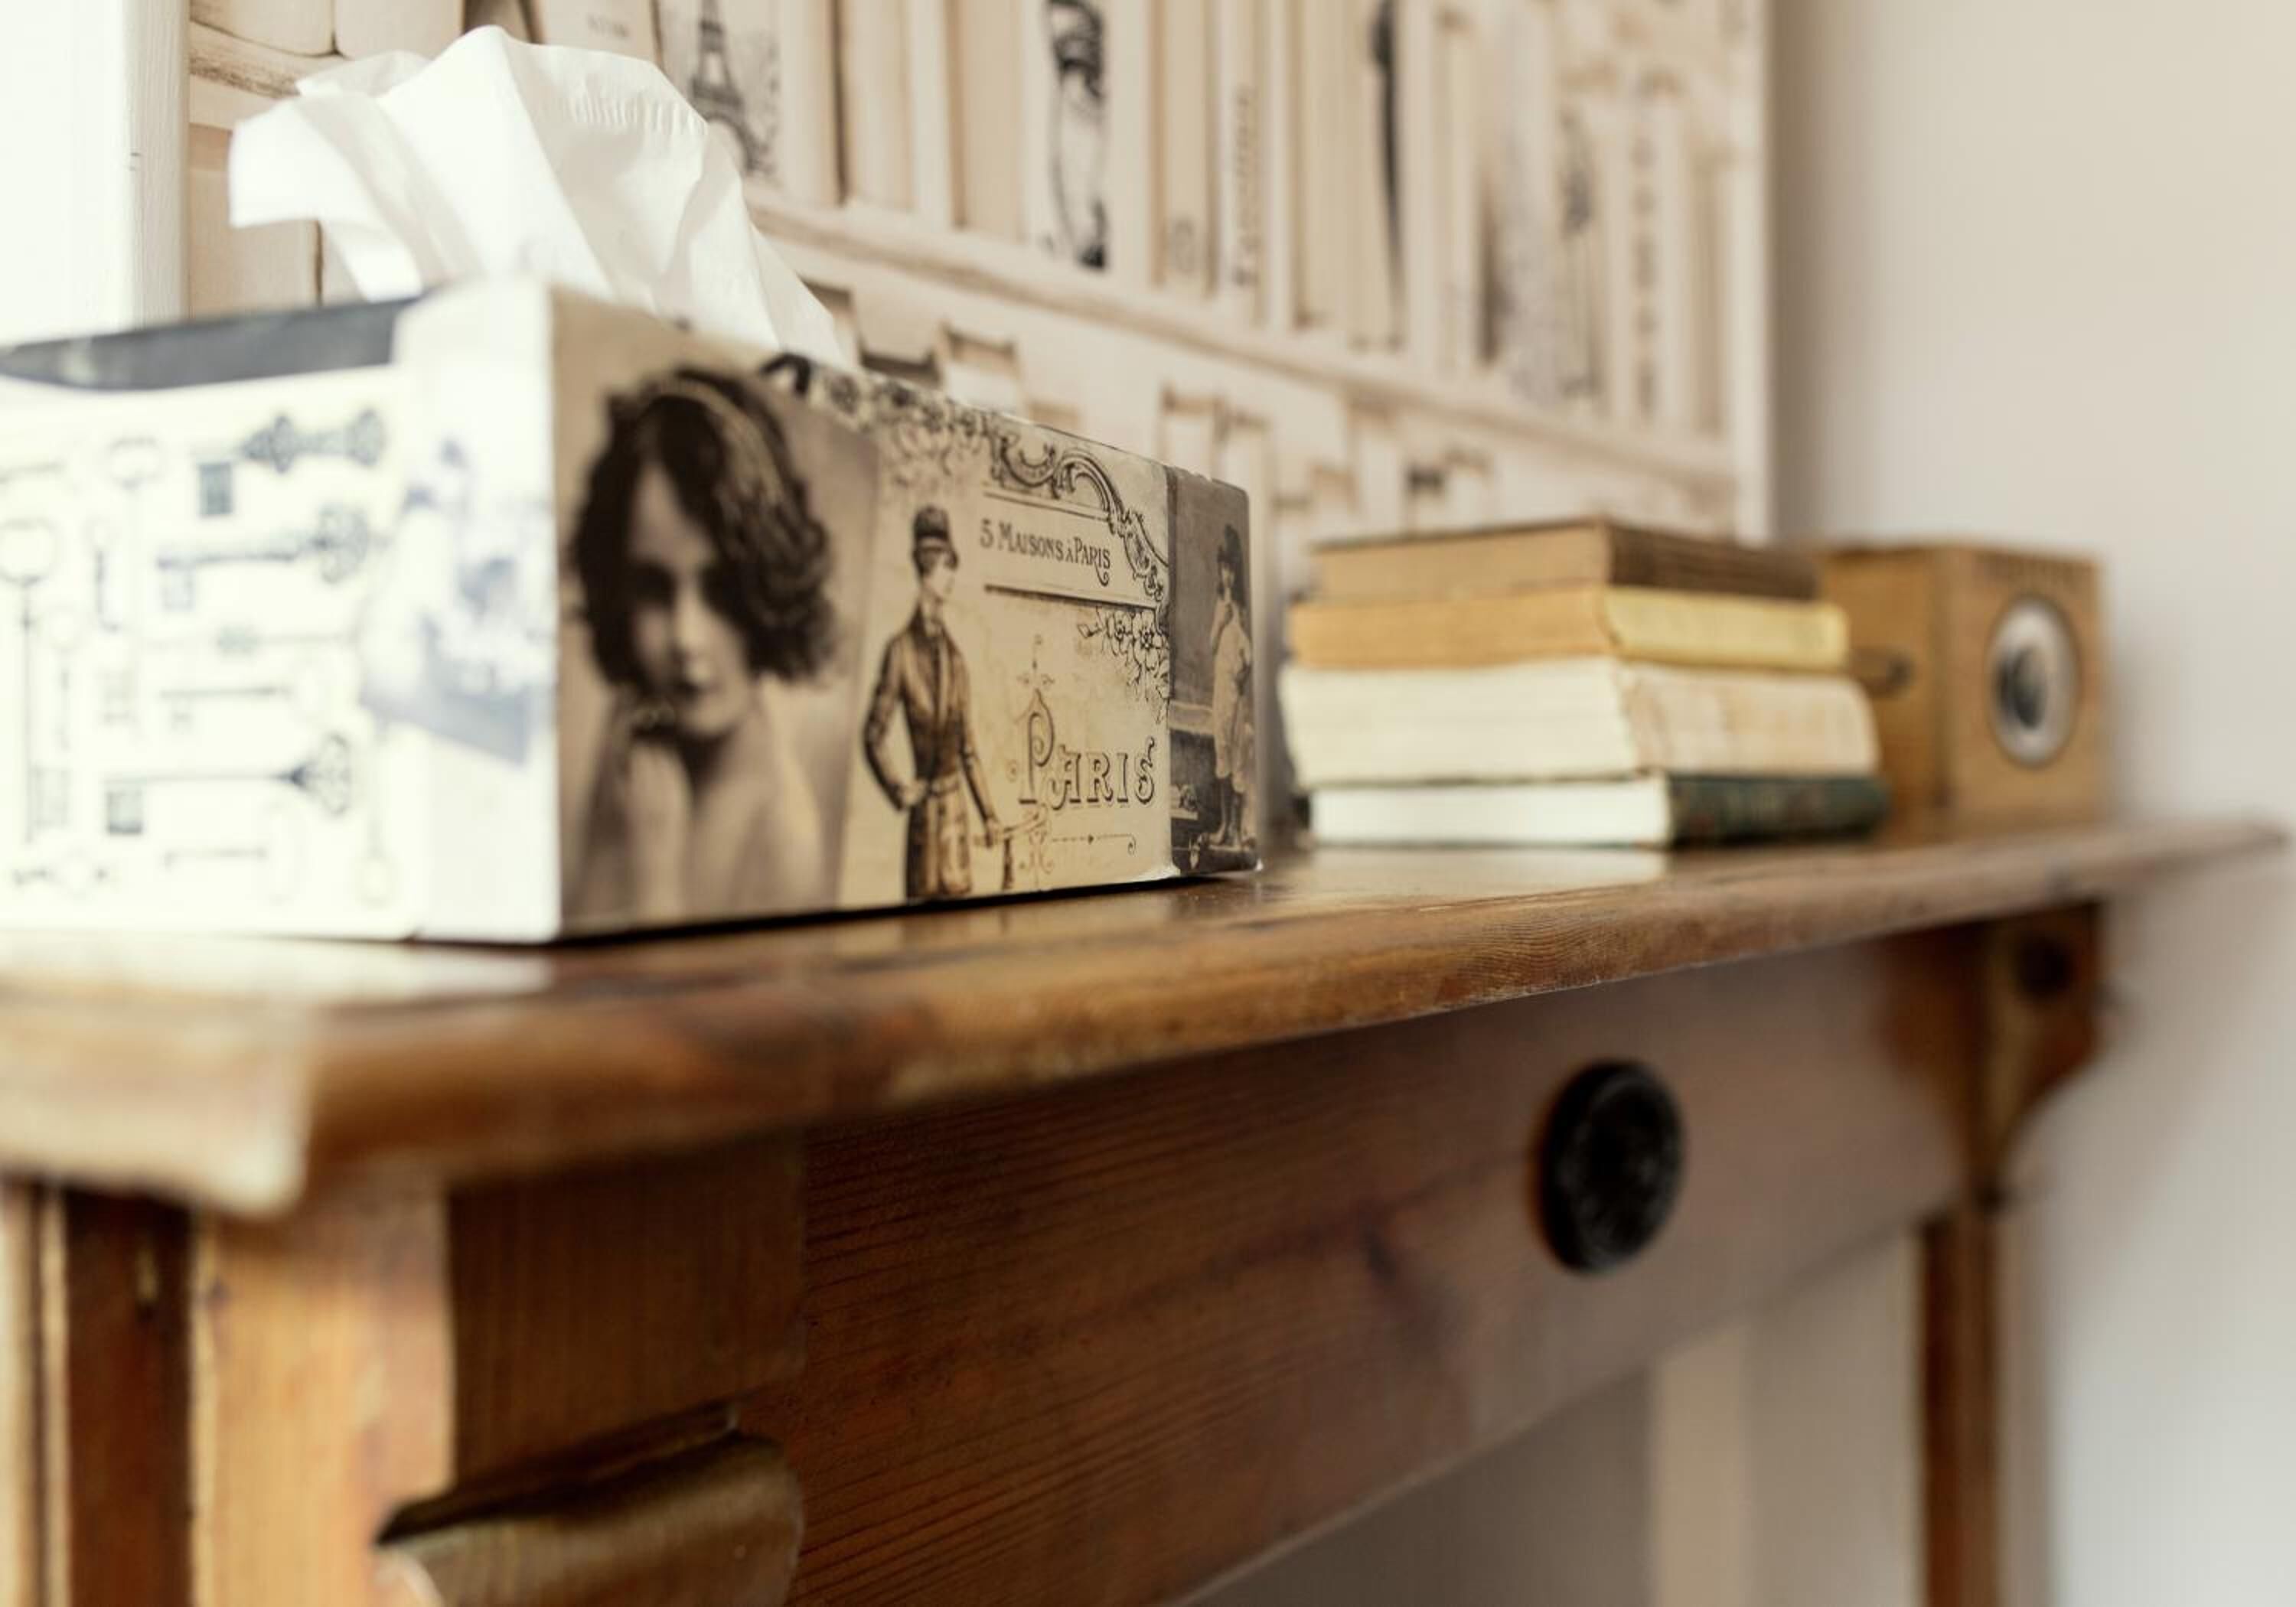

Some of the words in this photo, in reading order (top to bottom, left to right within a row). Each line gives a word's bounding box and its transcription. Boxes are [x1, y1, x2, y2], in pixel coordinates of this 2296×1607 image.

[997, 520, 1065, 562] MAISONS
[1073, 536, 1111, 587] PARIS
[1019, 689, 1156, 810] PARIS
